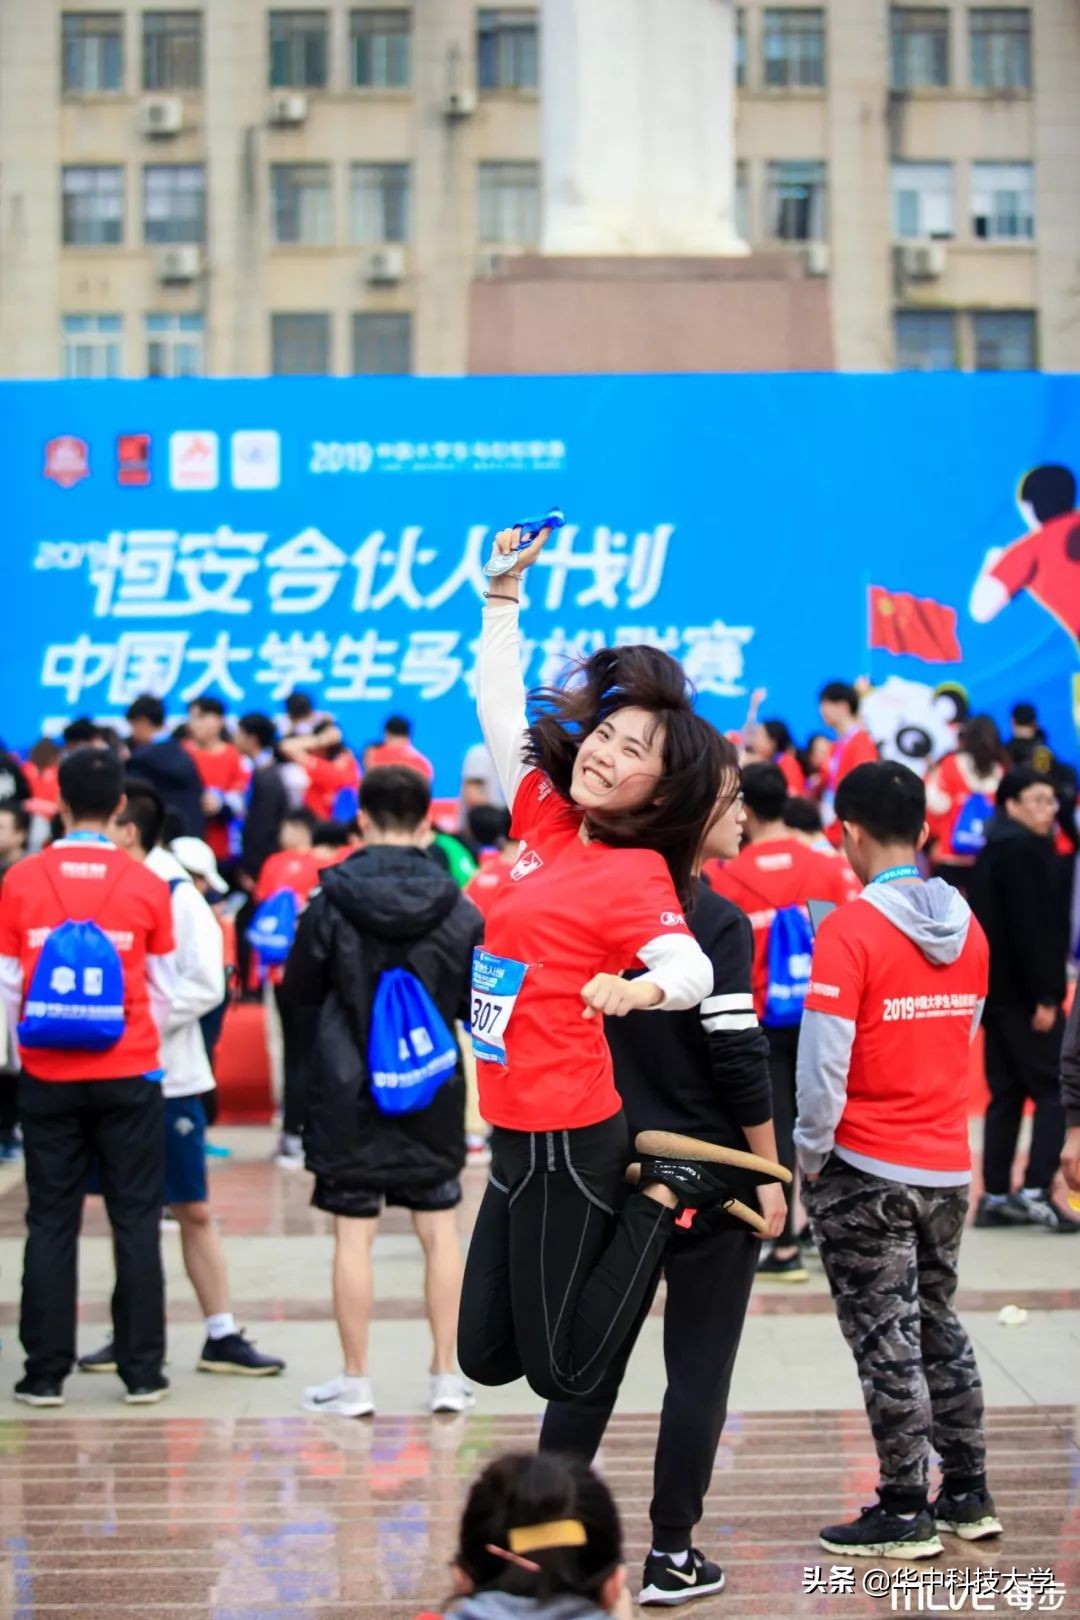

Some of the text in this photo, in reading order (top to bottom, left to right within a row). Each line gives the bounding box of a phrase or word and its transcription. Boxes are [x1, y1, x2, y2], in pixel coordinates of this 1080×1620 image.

[89, 525, 674, 617] 恒安合伙人计划
[883, 997, 914, 1021] 2019
